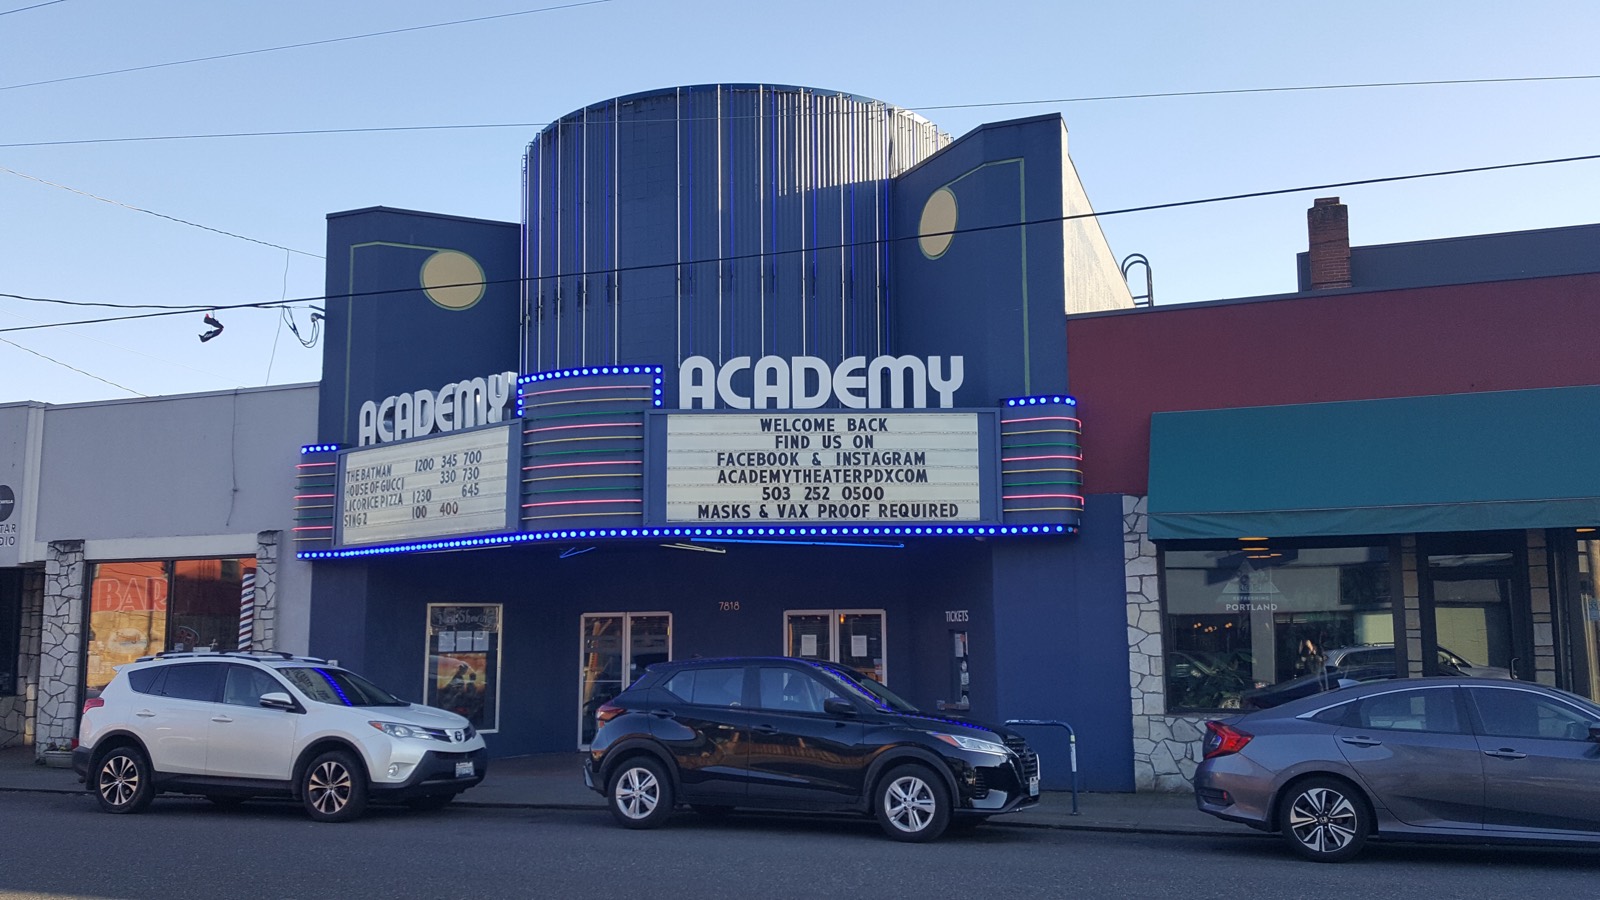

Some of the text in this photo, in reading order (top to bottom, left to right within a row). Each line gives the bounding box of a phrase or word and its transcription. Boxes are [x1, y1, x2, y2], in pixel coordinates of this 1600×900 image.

[678, 355, 965, 409] ACADEMY
[359, 371, 518, 446] ACADEMY
[760, 418, 888, 432] WELCOME BACK
[775, 434, 874, 449] FIND US ON
[361, 464, 393, 481] BATMAN
[415, 458, 434, 472] 1200
[441, 454, 457, 468] 345
[463, 450, 482, 465] 700
[717, 452, 926, 466] FACEBOOK & INSTAGRAM
[370, 481, 379, 494] OF
[380, 477, 404, 492] GUCCI
[440, 470, 456, 484] 330
[462, 466, 480, 481] 730
[717, 469, 928, 483] ACADEMYTHEATERPDXCOM
[380, 493, 403, 508] PIZZA
[413, 489, 432, 504] 1230
[461, 483, 479, 497] 645
[762, 486, 884, 501] 503 252 0500
[344, 512, 362, 527] SING
[412, 505, 427, 519] 100
[440, 501, 458, 516] 400
[697, 503, 959, 519] MASKS & VAX PROOF REQUIRED
[718, 601, 740, 611] 7818
[1225, 603, 1278, 611] PORTLAND
[945, 610, 969, 622] TICKETS
